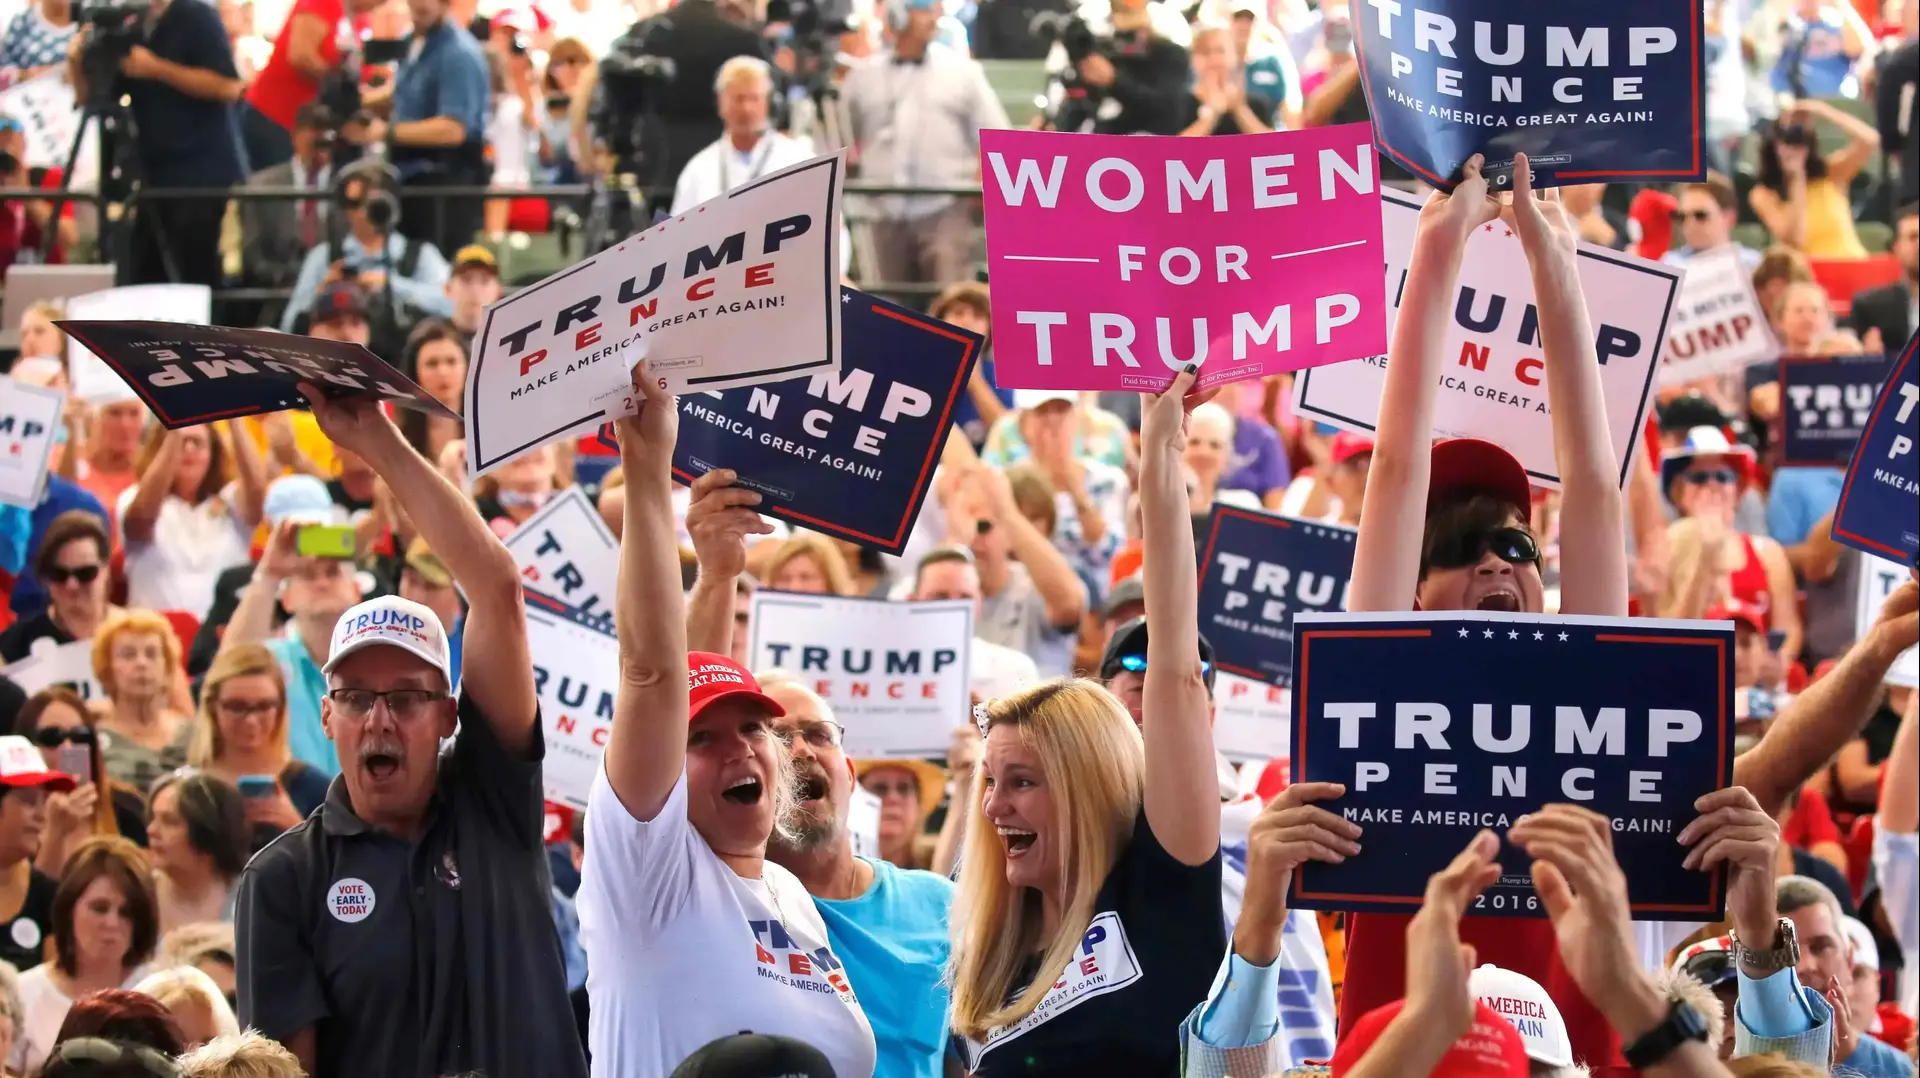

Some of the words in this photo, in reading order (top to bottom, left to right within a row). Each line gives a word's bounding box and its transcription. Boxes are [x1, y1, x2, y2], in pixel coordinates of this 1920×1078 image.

[1367, 0, 1678, 66] TRUMP
[1390, 51, 1643, 103] PENCE
[1387, 87, 1424, 113] MAKE
[1428, 104, 1509, 127] AMERICA
[1515, 112, 1578, 127] GREAT
[1585, 111, 1654, 124] AGAIN!
[987, 143, 1375, 213] WOMEN
[1118, 245, 1251, 285] FOR
[499, 214, 812, 357] TRUMP
[520, 262, 775, 376] PENCE
[1016, 293, 1362, 371] TRUMP
[510, 371, 558, 400] MAKE
[565, 333, 642, 375] AMERICA
[648, 308, 708, 333] GREAT
[715, 295, 786, 316] AGAIN!
[1664, 314, 1752, 364] UMP
[148, 358, 416, 399] TRUMP
[1124, 377, 1138, 389] Paid
[1139, 378, 1149, 389] for
[1150, 379, 1157, 392] by
[1474, 385, 1530, 408] GREAT
[1787, 384, 1883, 411] TRU
[683, 401, 754, 439] AMERICA
[760, 432, 816, 461] GREAT
[820, 453, 883, 481] AGAIN!
[1874, 467, 1905, 489] MAKE
[1217, 552, 1351, 610] TRU
[345, 609, 424, 634] TRUMP
[386, 625, 408, 633] GREAT
[700, 664, 742, 676] AMERICA
[767, 642, 956, 675] TRUMP
[688, 674, 708, 691] EAT
[815, 680, 938, 699] ENCE
[1323, 702, 1703, 757] TRUMP
[1355, 762, 1663, 802] PENCE
[1343, 807, 1403, 823] MAKE
[1411, 810, 1509, 827] AMERICA
[1611, 817, 1672, 833] GAIN!
[338, 885, 364, 895] VOTE
[1502, 877, 1521, 885] Trump
[336, 895, 366, 905] EARLY
[336, 905, 367, 915] TODAY
[1475, 894, 1537, 910] 2016
[757, 966, 788, 986] MAKE
[790, 979, 836, 995] AMERICA
[1038, 990, 1069, 1011] GREAT
[1071, 974, 1108, 994] AGAIN!
[1026, 1012, 1049, 1028] 2016
[1505, 1018, 1544, 1038] AIN
